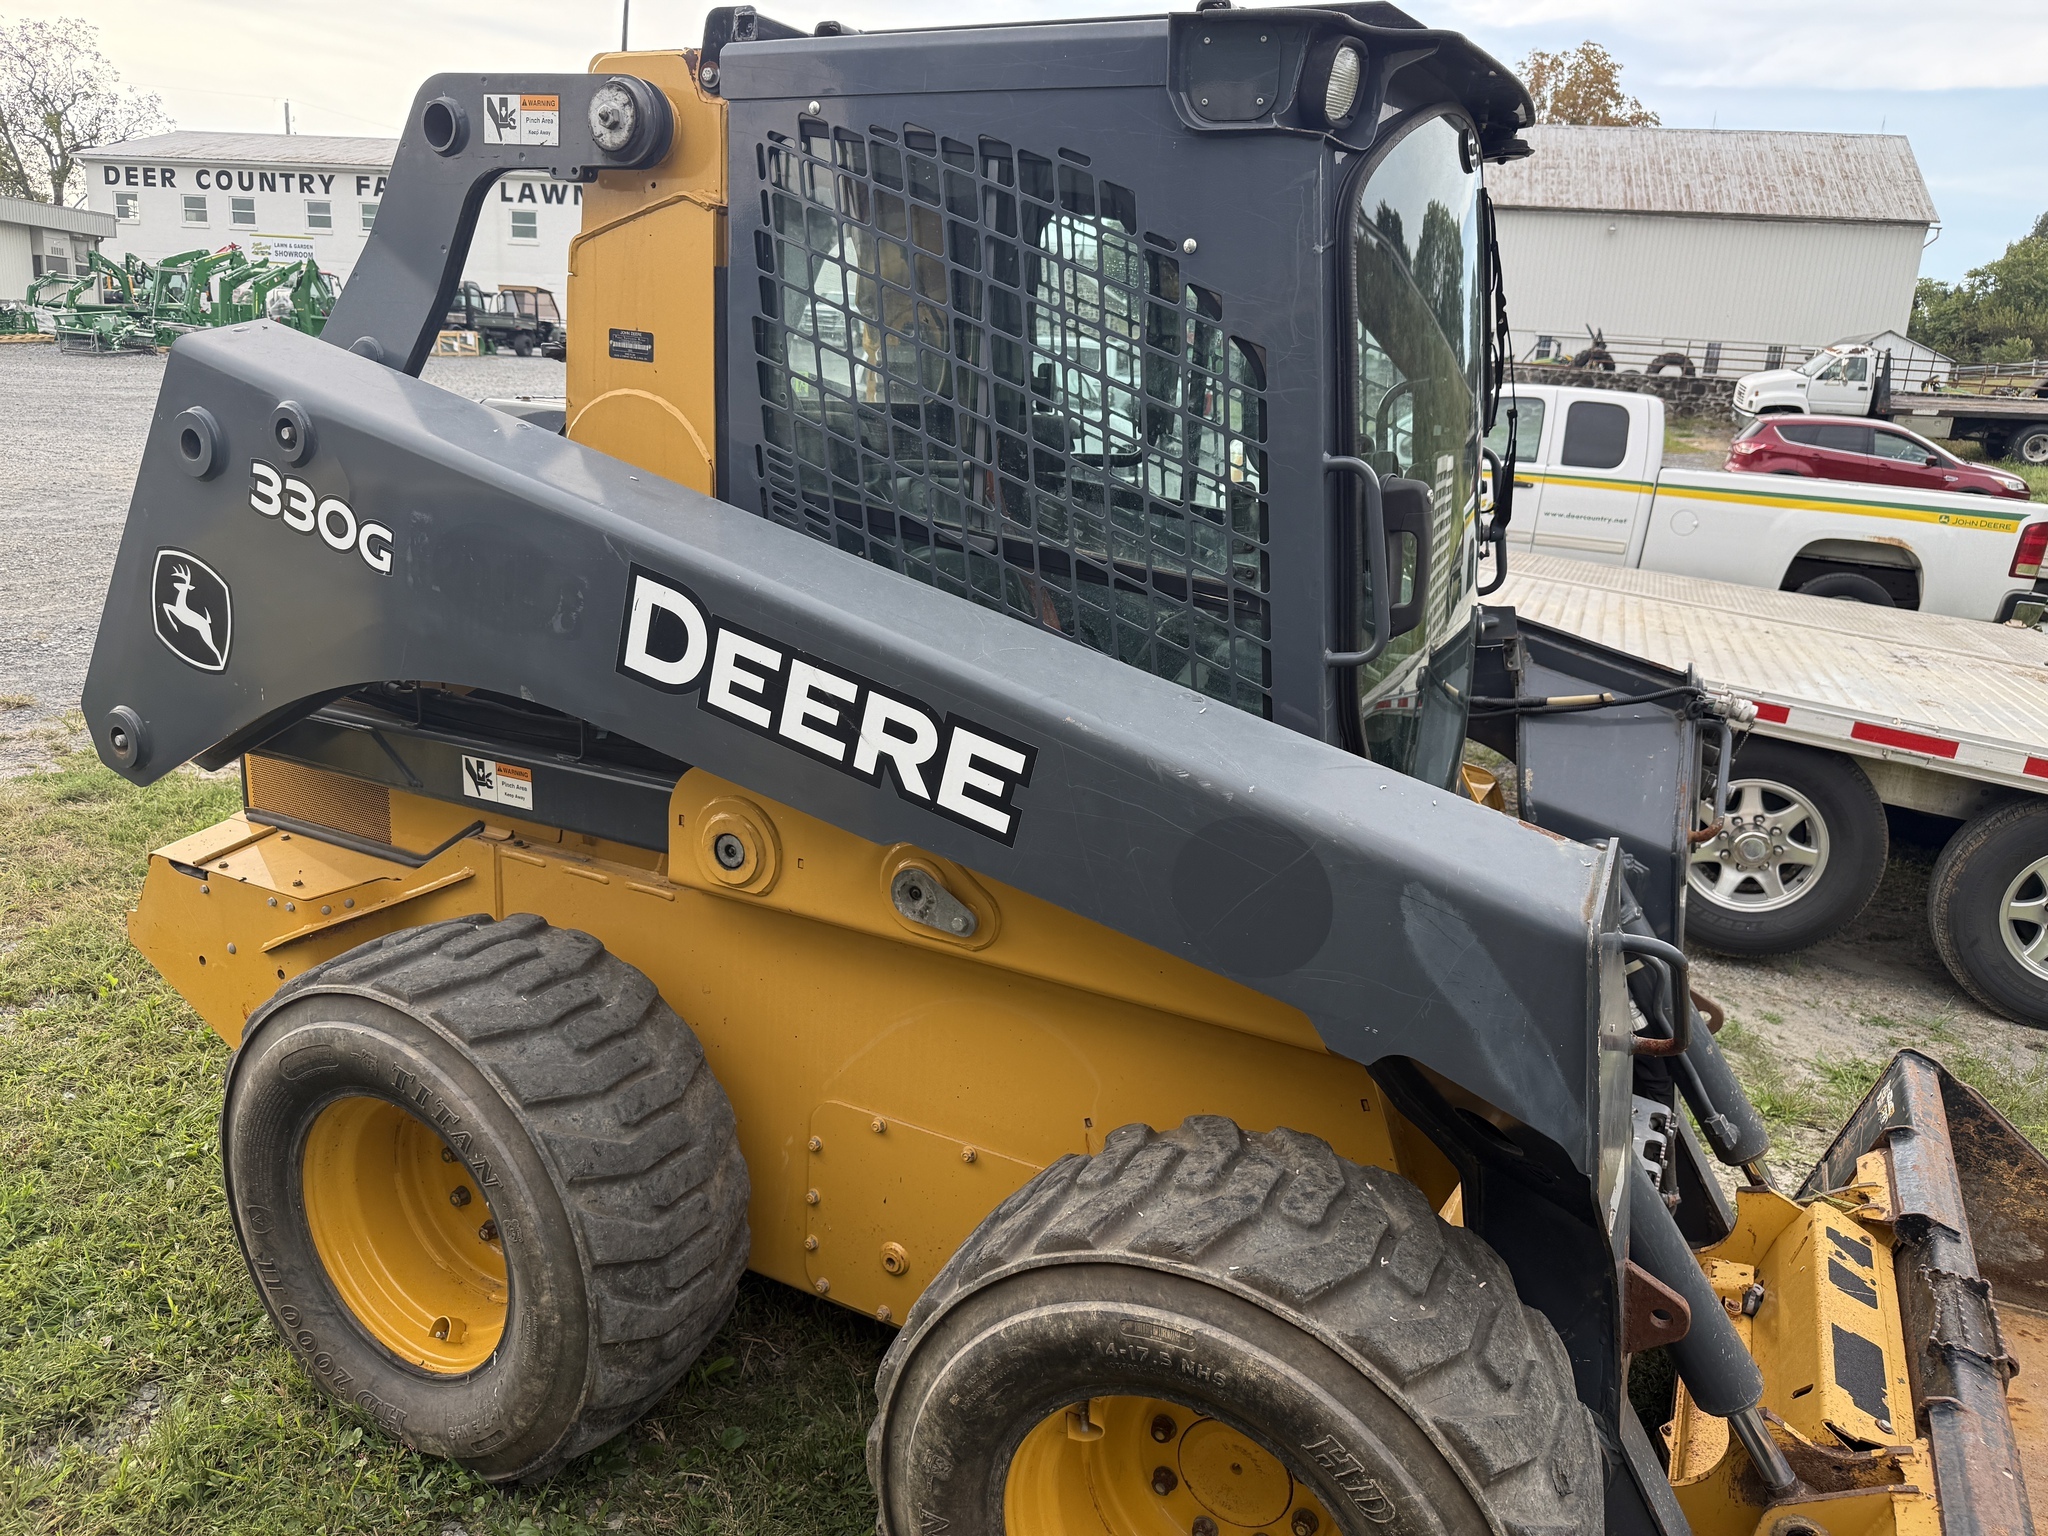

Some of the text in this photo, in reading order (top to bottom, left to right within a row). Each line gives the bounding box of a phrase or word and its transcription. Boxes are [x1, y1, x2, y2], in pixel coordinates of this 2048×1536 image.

[528, 99, 556, 107] WARNING
[103, 165, 177, 188] DEER
[195, 168, 336, 194] COUNTRY
[274, 250, 314, 258] SHOWROOM
[250, 461, 395, 574] 330G
[1544, 511, 1628, 524] www.deercountry.net
[1952, 517, 2012, 531] JOHN DEERE
[623, 574, 1027, 835] DEERE
[503, 767, 529, 778] WARNING
[502, 781, 516, 789] Pinch
[391, 1061, 504, 1192] TITAN
[1181, 1357, 1227, 1388] NHS
[1301, 1434, 1396, 1523] HD
